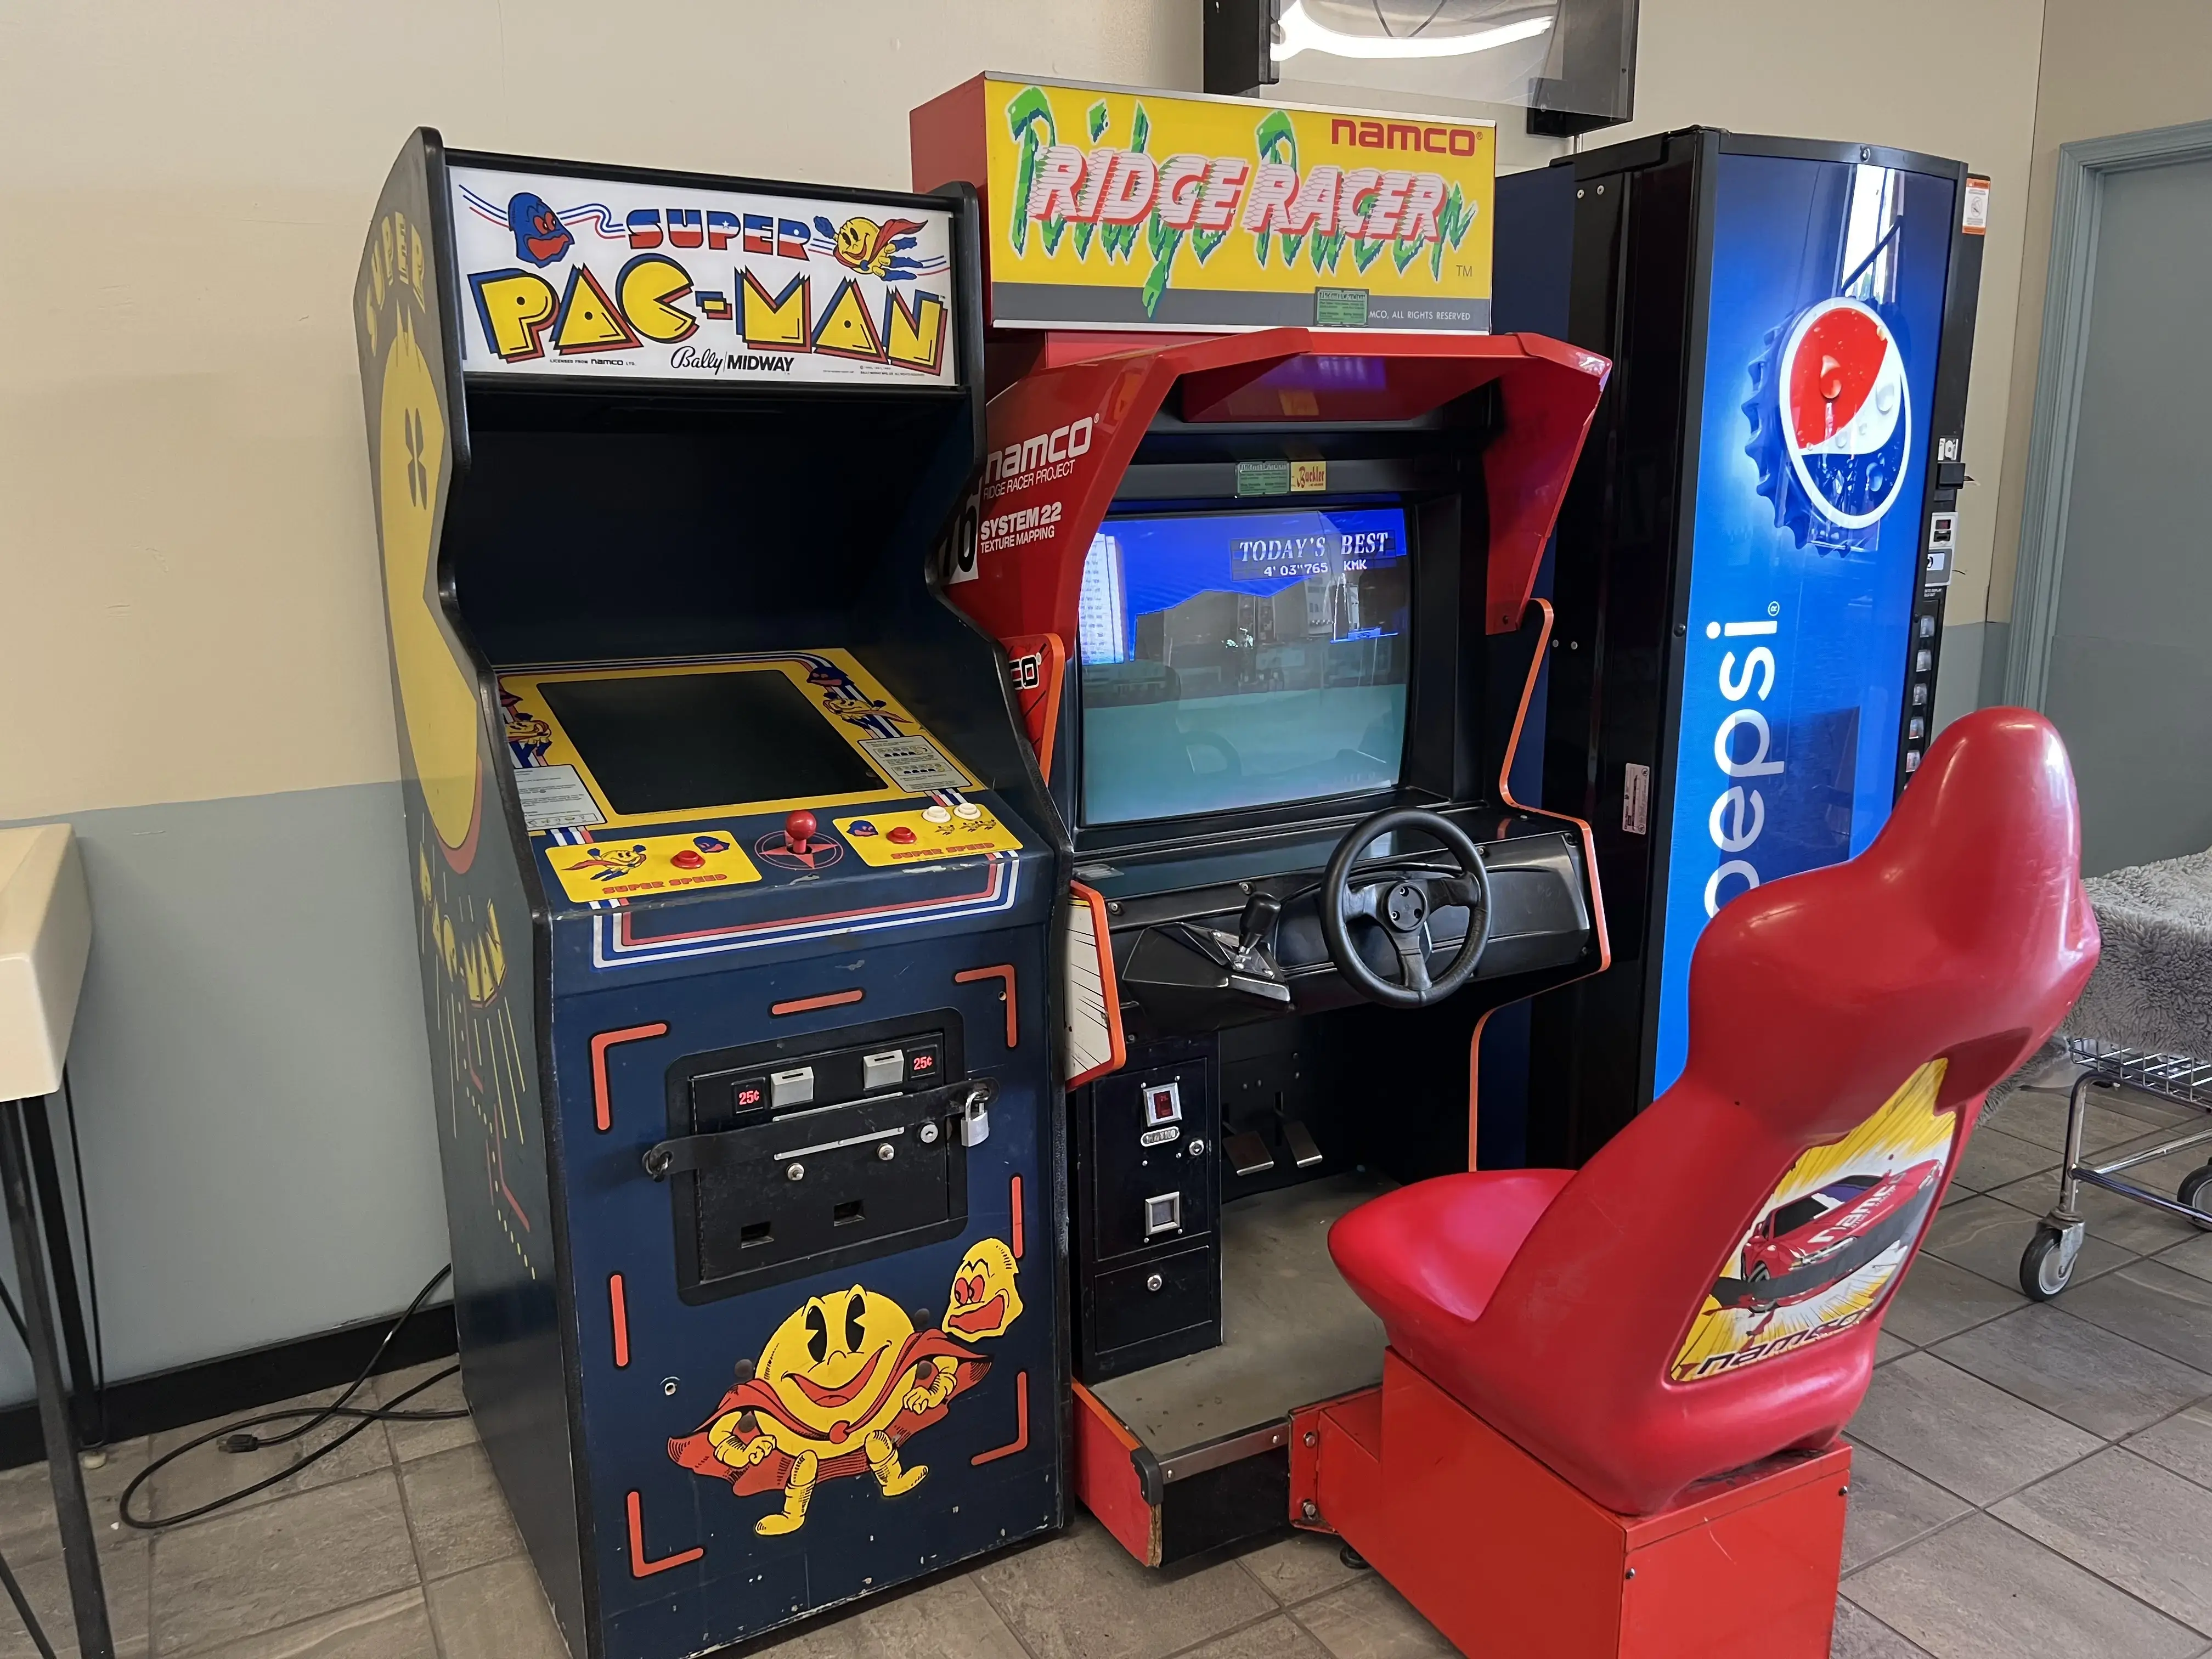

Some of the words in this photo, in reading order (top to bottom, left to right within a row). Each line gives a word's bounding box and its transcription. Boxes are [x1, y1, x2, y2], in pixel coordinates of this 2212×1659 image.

[1331, 119, 1476, 157] namco
[1026, 145, 1249, 230] RIDGE
[1242, 161, 1449, 242] RACER
[624, 207, 812, 261] SUPER
[1456, 264, 1473, 279] TM
[467, 252, 949, 376] PAC-MAN
[1368, 310, 1389, 319] MCO,
[1392, 311, 1404, 319] ALL
[1407, 311, 1433, 320] RIGHTS
[1436, 311, 1471, 320] RESERVED
[670, 346, 724, 375] Bally
[726, 354, 795, 372] MIDWAY
[985, 416, 1093, 484] namco
[983, 482, 1006, 501] RIDGE
[1007, 475, 1034, 494] RACER
[1035, 459, 1076, 486] PROJECT
[980, 506, 1040, 541] SYSTEM
[1040, 501, 1062, 525] 22
[980, 537, 1015, 554] TEXTURE
[1015, 525, 1055, 546] MAPPING
[1239, 535, 1326, 562] TODAY'S
[1340, 532, 1389, 555] BEST
[1344, 559, 1368, 571] KMK
[890, 848, 944, 860] SUPER
[945, 842, 995, 853] SPEED
[602, 881, 665, 895] SUPER
[669, 873, 727, 886] SPEED
[913, 1056, 933, 1071] 25¢
[738, 1090, 760, 1106] 25¢
